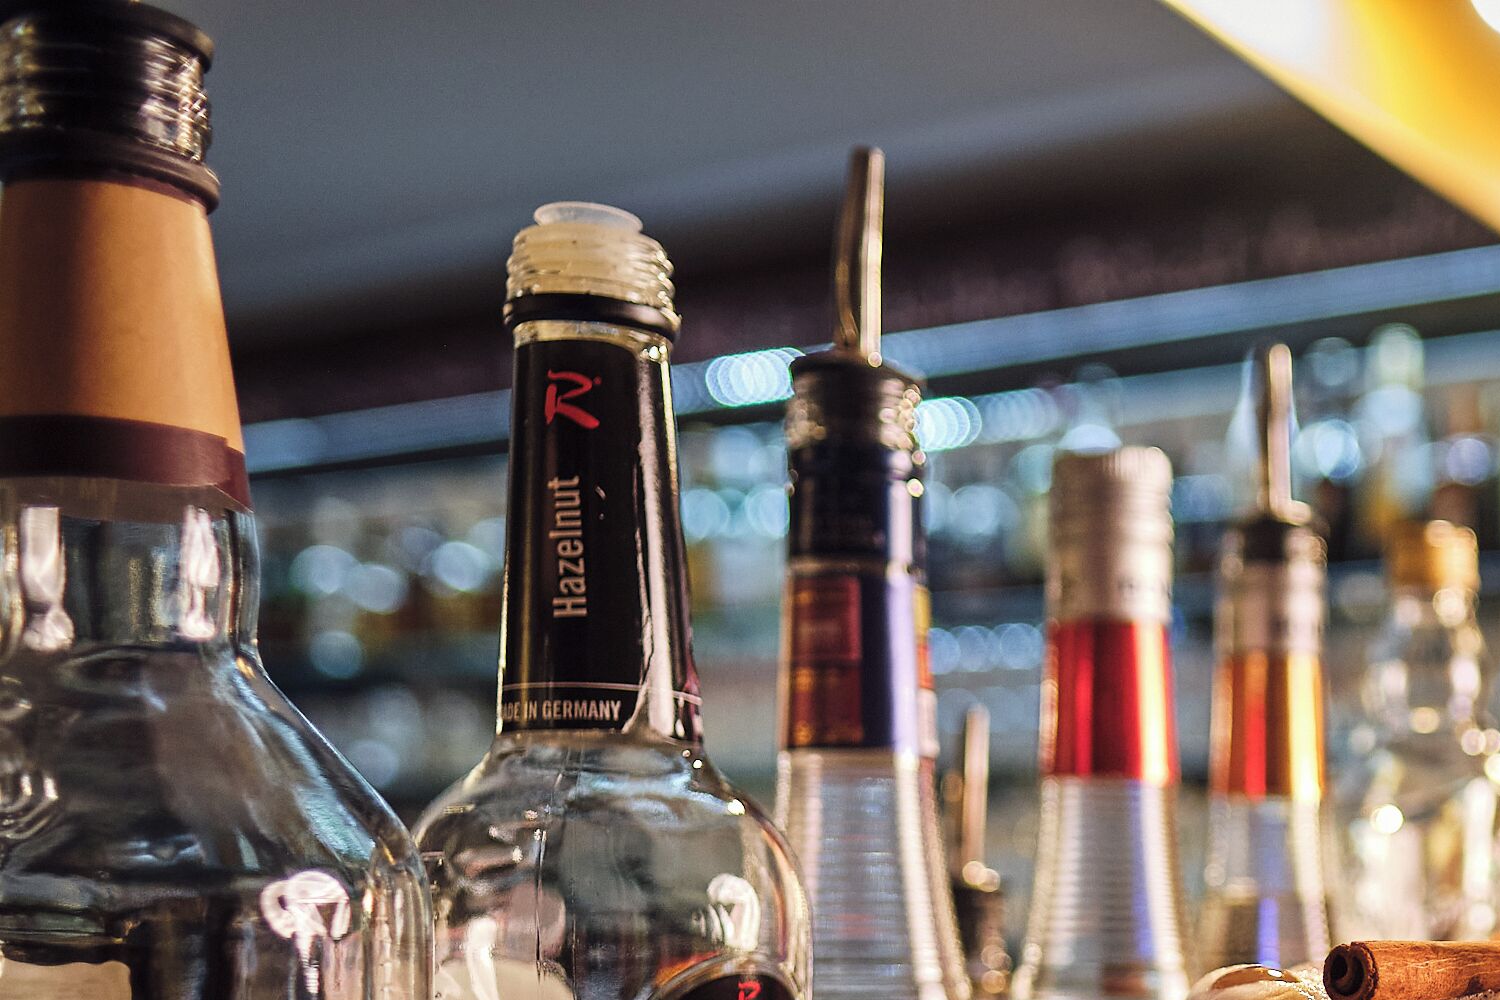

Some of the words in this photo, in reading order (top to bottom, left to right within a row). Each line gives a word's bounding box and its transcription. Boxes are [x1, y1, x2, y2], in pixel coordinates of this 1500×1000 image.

[547, 474, 588, 618] Hazelnut
[500, 701, 520, 721] ADE
[523, 701, 538, 720] IN
[541, 700, 621, 721] GERMANY
